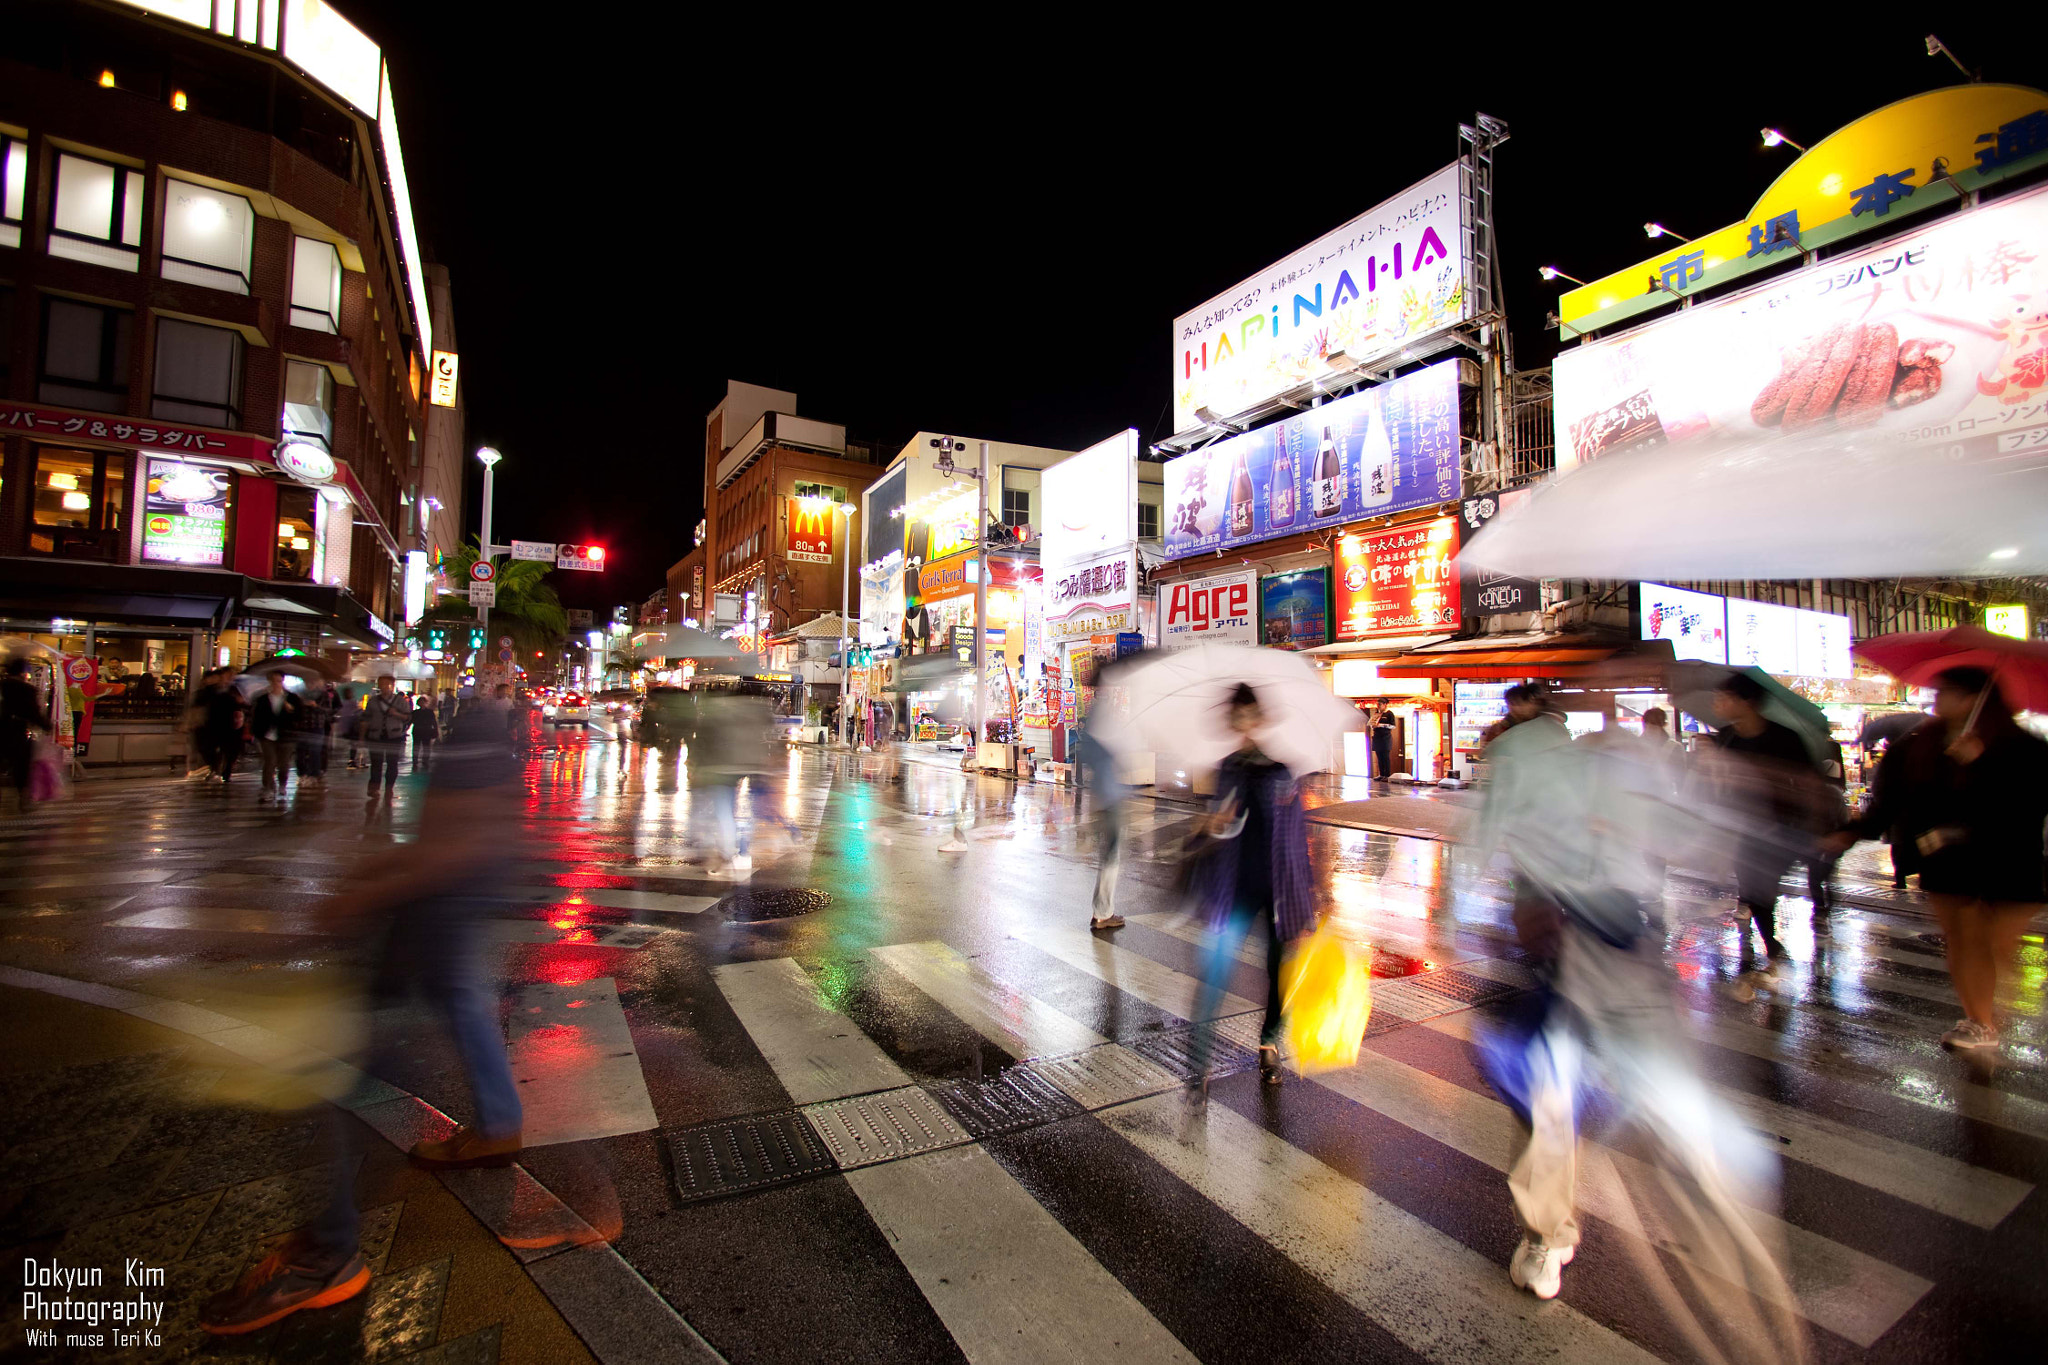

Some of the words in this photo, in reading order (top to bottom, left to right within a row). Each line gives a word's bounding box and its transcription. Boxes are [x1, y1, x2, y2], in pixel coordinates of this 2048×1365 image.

[1815, 244, 1930, 297] フジバンビ
[795, 540, 815, 552] 80m
[941, 569, 962, 584] Terra
[1168, 583, 1248, 632] Agre
